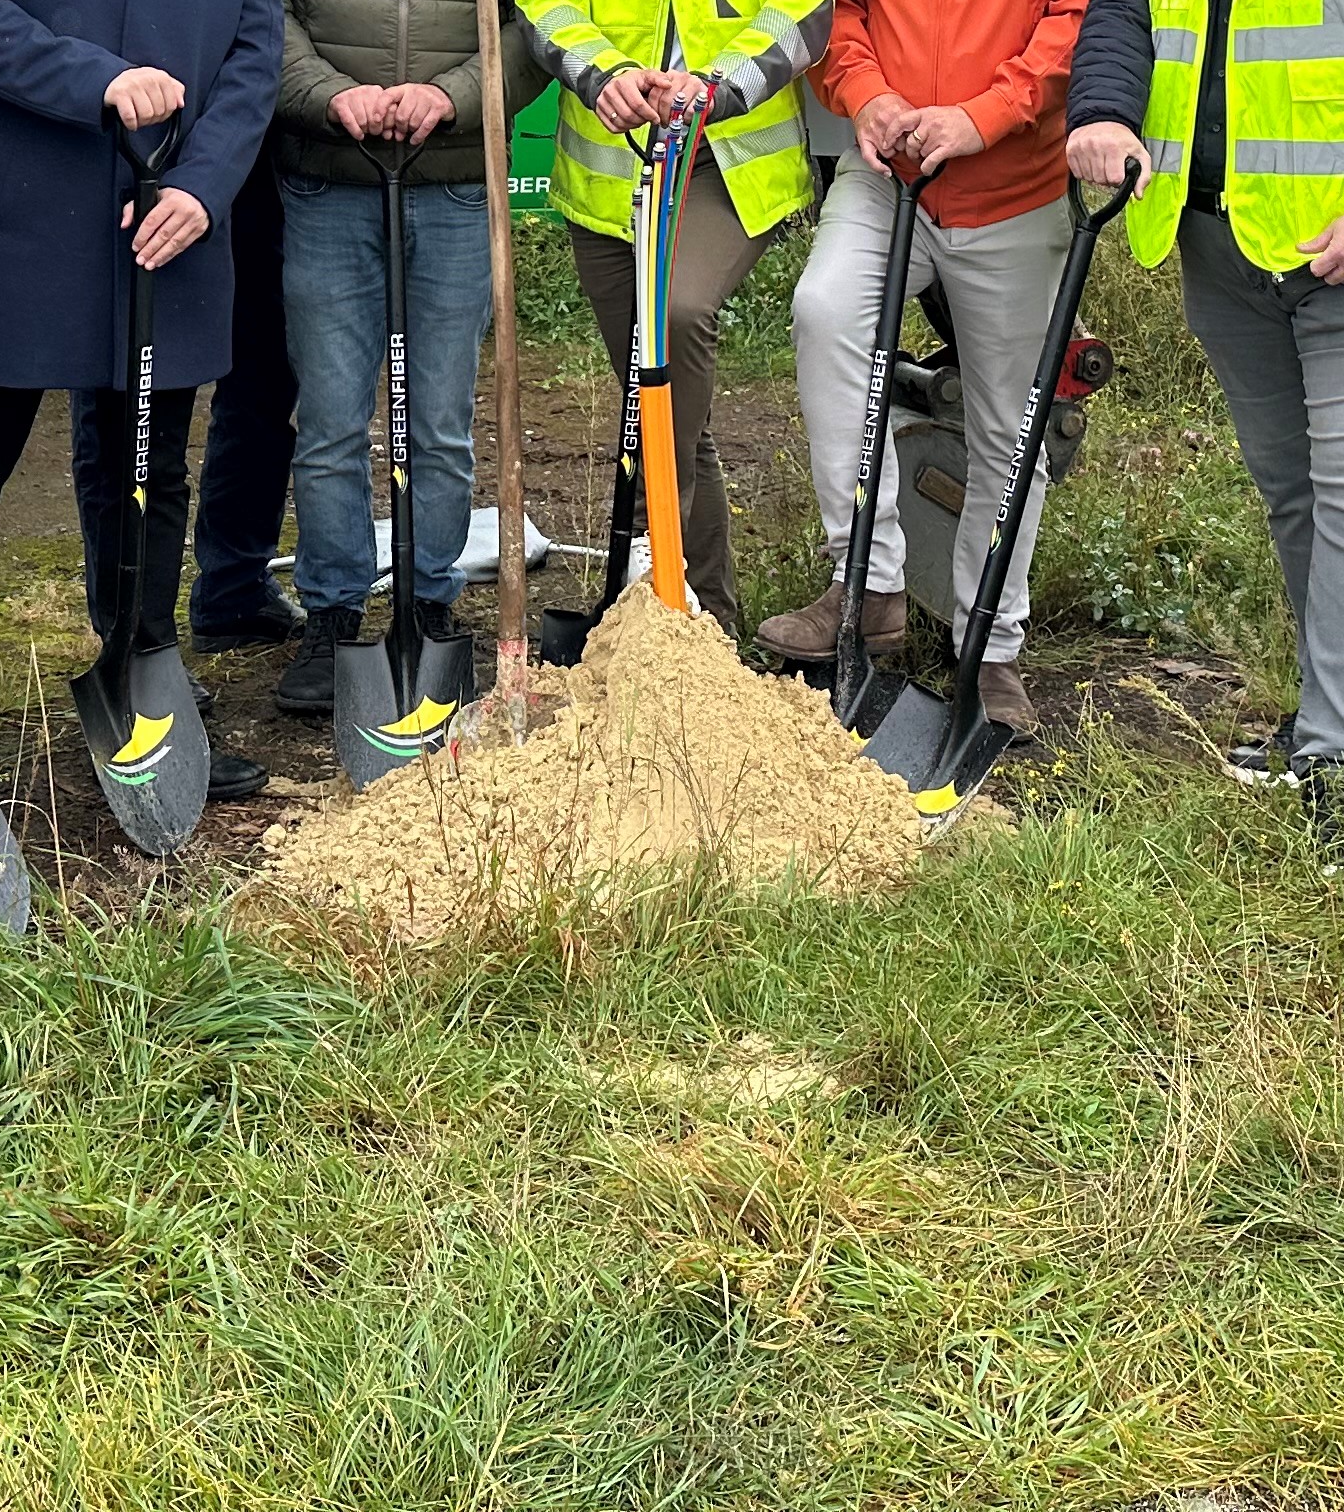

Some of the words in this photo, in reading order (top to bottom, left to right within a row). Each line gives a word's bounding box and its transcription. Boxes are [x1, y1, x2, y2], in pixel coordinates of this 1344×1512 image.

[138, 345, 153, 482] GREENFIBER
[390, 333, 407, 462] GREENFIBER
[858, 349, 888, 480] GREENFIBER
[996, 386, 1042, 522] GREENFIBER
